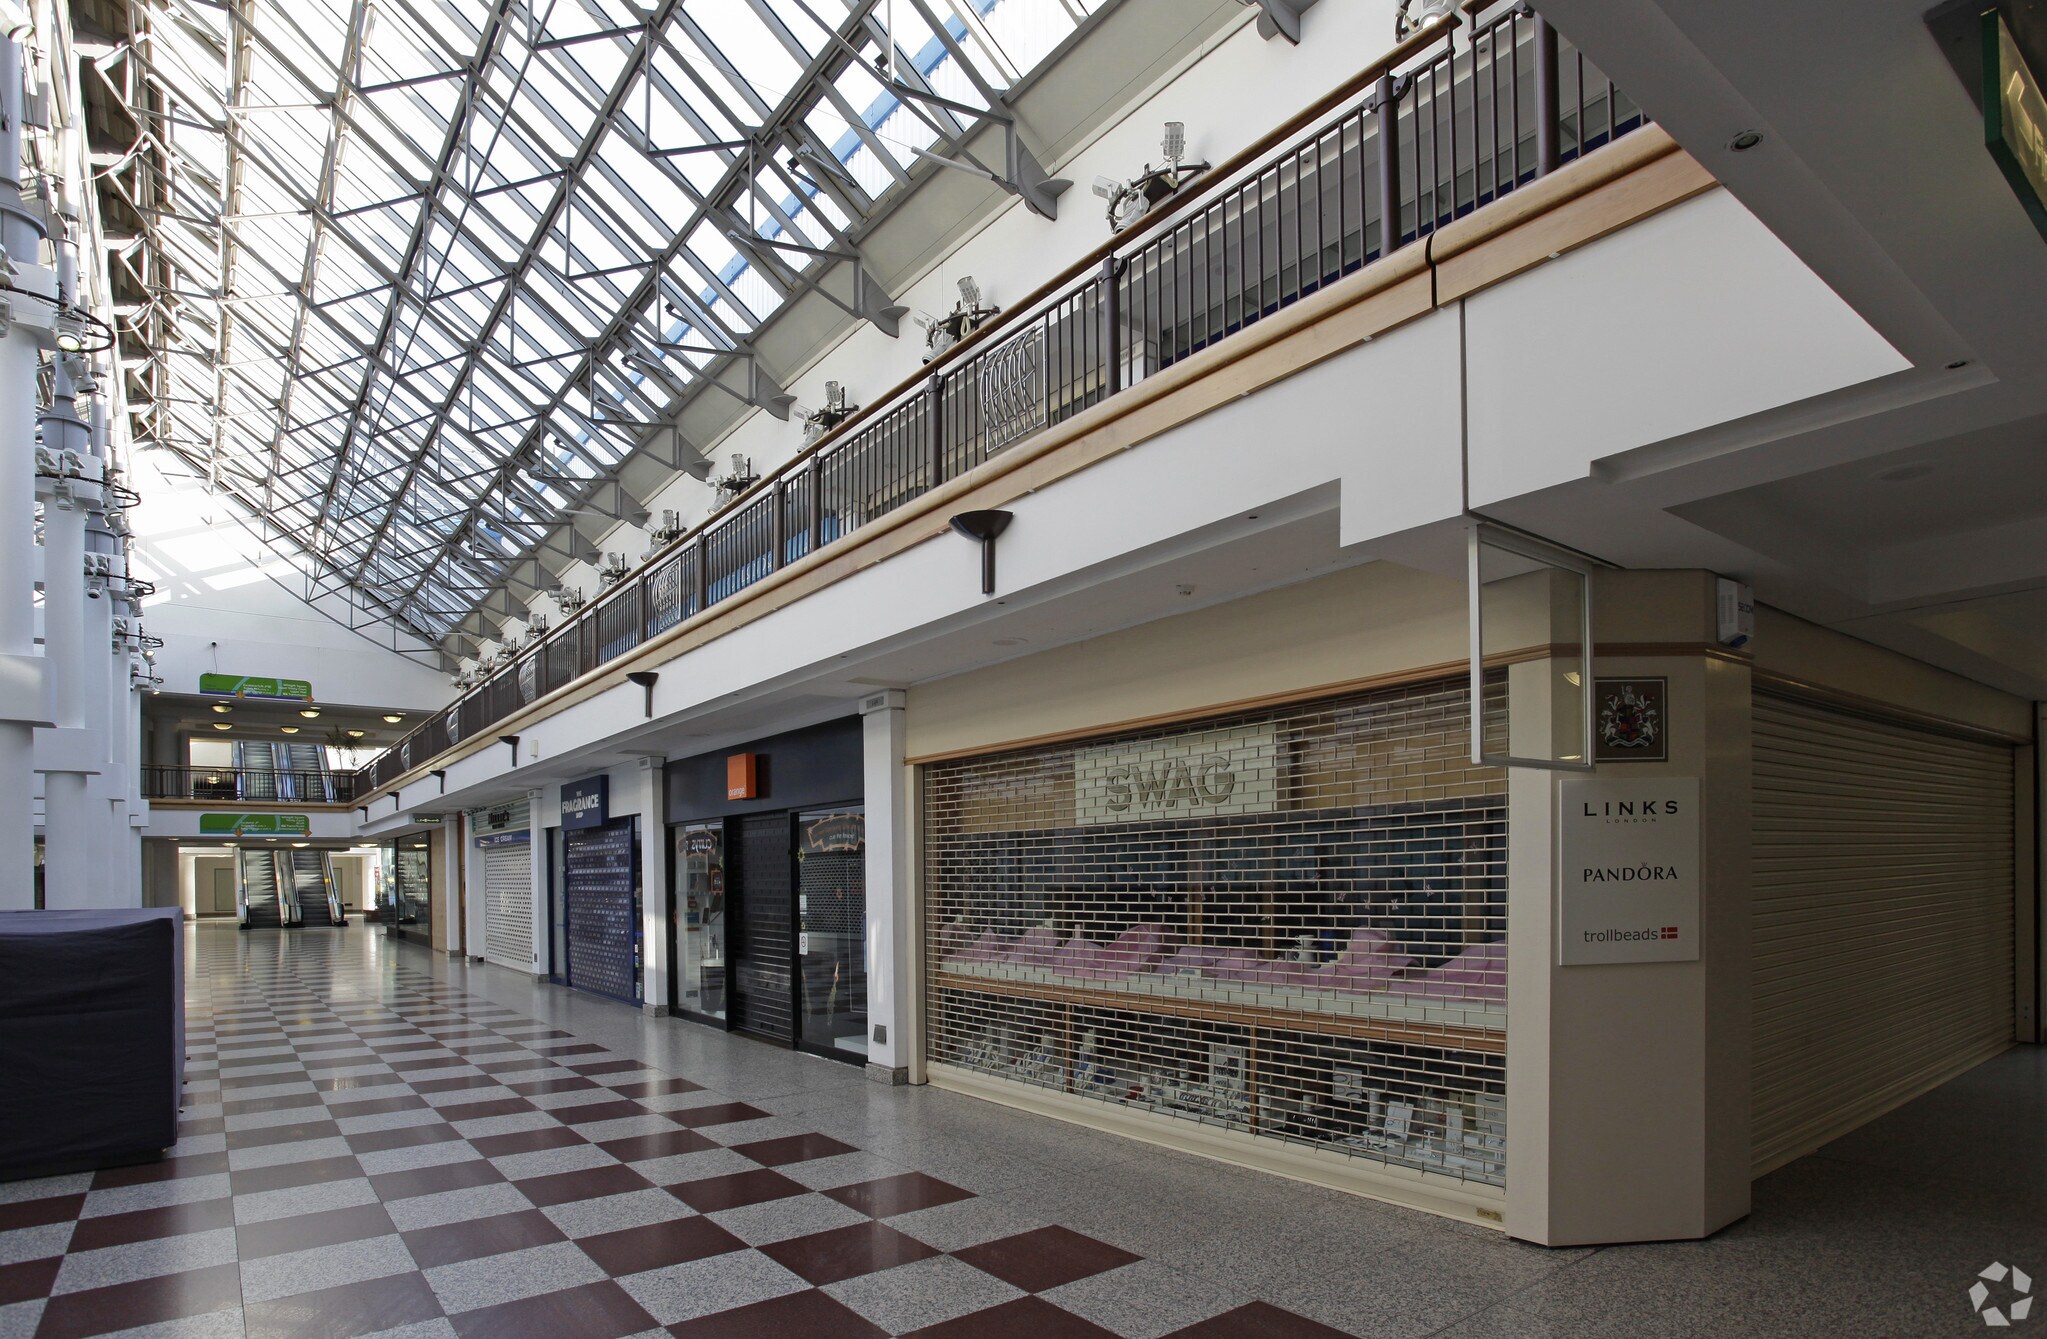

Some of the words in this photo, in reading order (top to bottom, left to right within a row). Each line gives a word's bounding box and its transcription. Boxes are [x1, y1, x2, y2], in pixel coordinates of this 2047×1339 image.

[1106, 756, 1235, 811] SWAG
[562, 794, 599, 814] FRAGRANCE
[1584, 800, 1678, 816] LINKS
[1584, 927, 1658, 943] trollbeads
